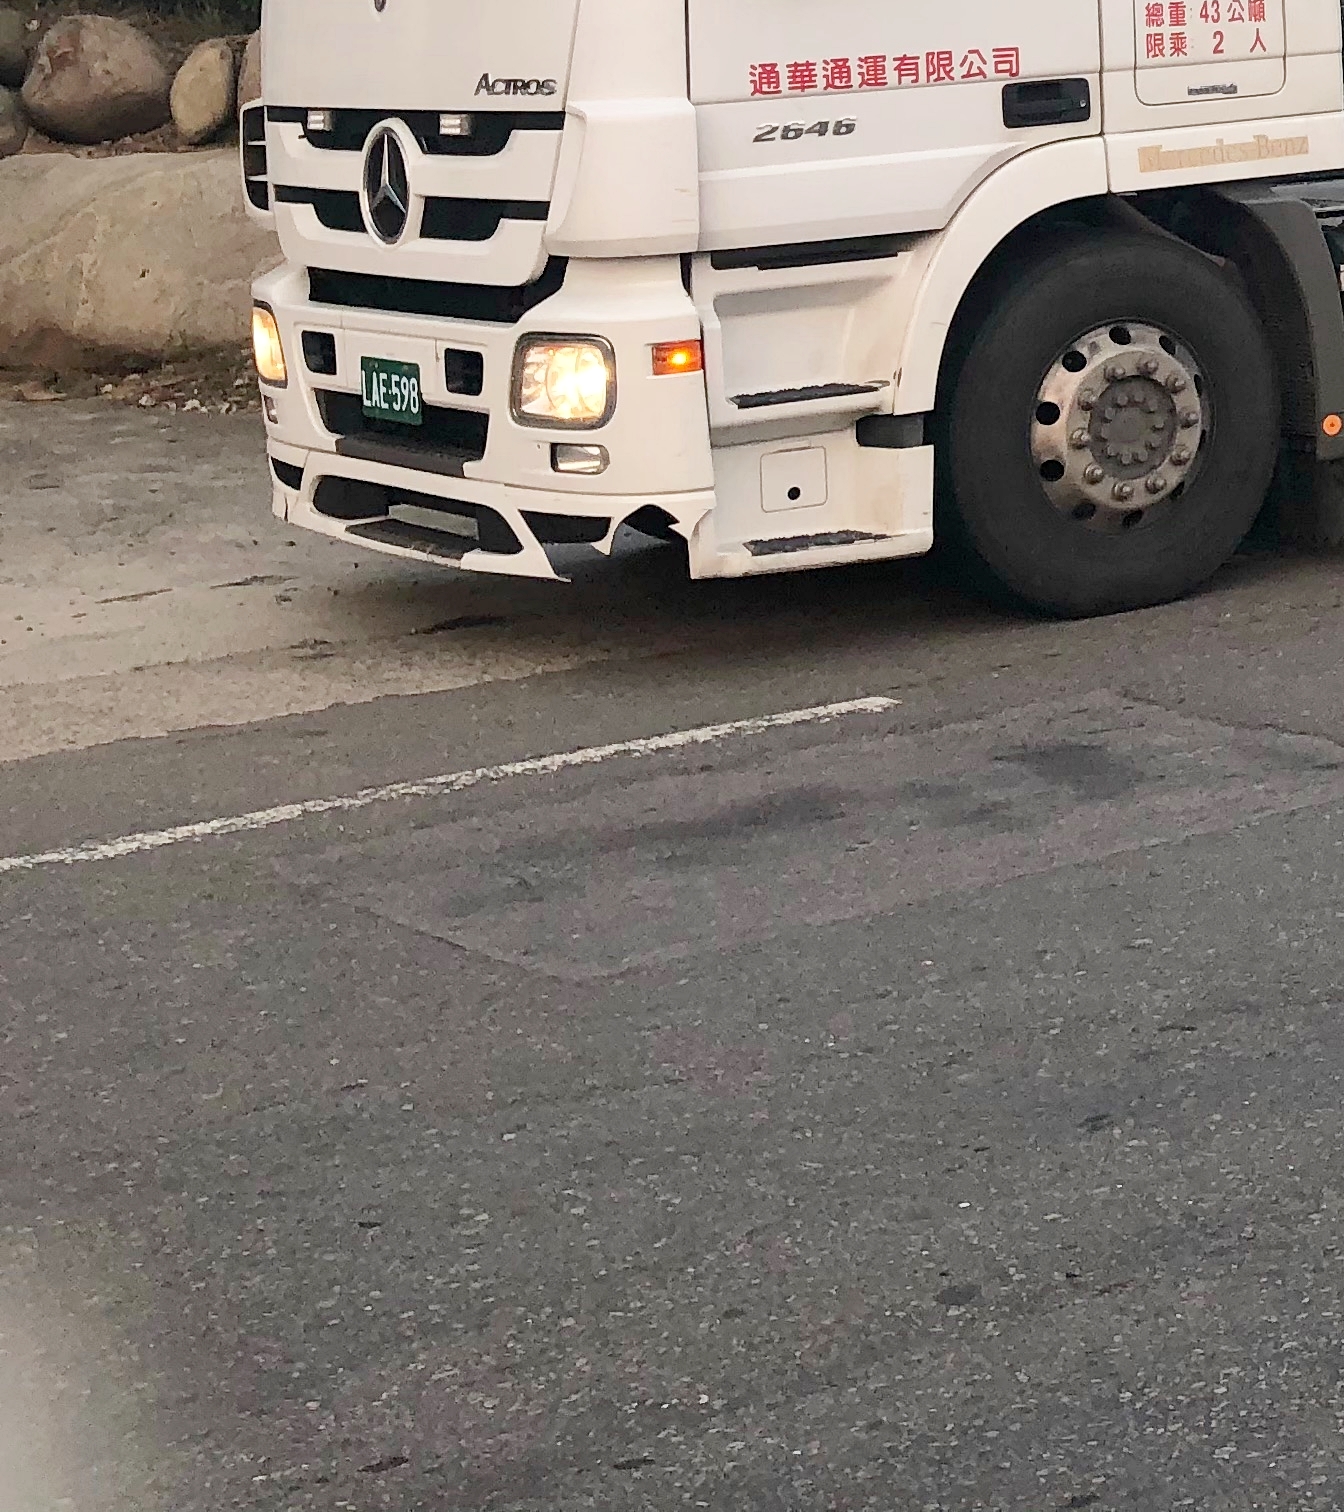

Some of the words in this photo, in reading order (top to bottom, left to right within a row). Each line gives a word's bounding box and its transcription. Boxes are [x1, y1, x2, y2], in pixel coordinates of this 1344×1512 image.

[1200, 0, 1221, 24] 43
[1213, 30, 1225, 55] 2
[1249, 28, 1267, 53] 人
[749, 46, 1021, 97] 通華通運有限公司
[752, 116, 857, 143] 2646
[361, 369, 420, 415] LAE-598
